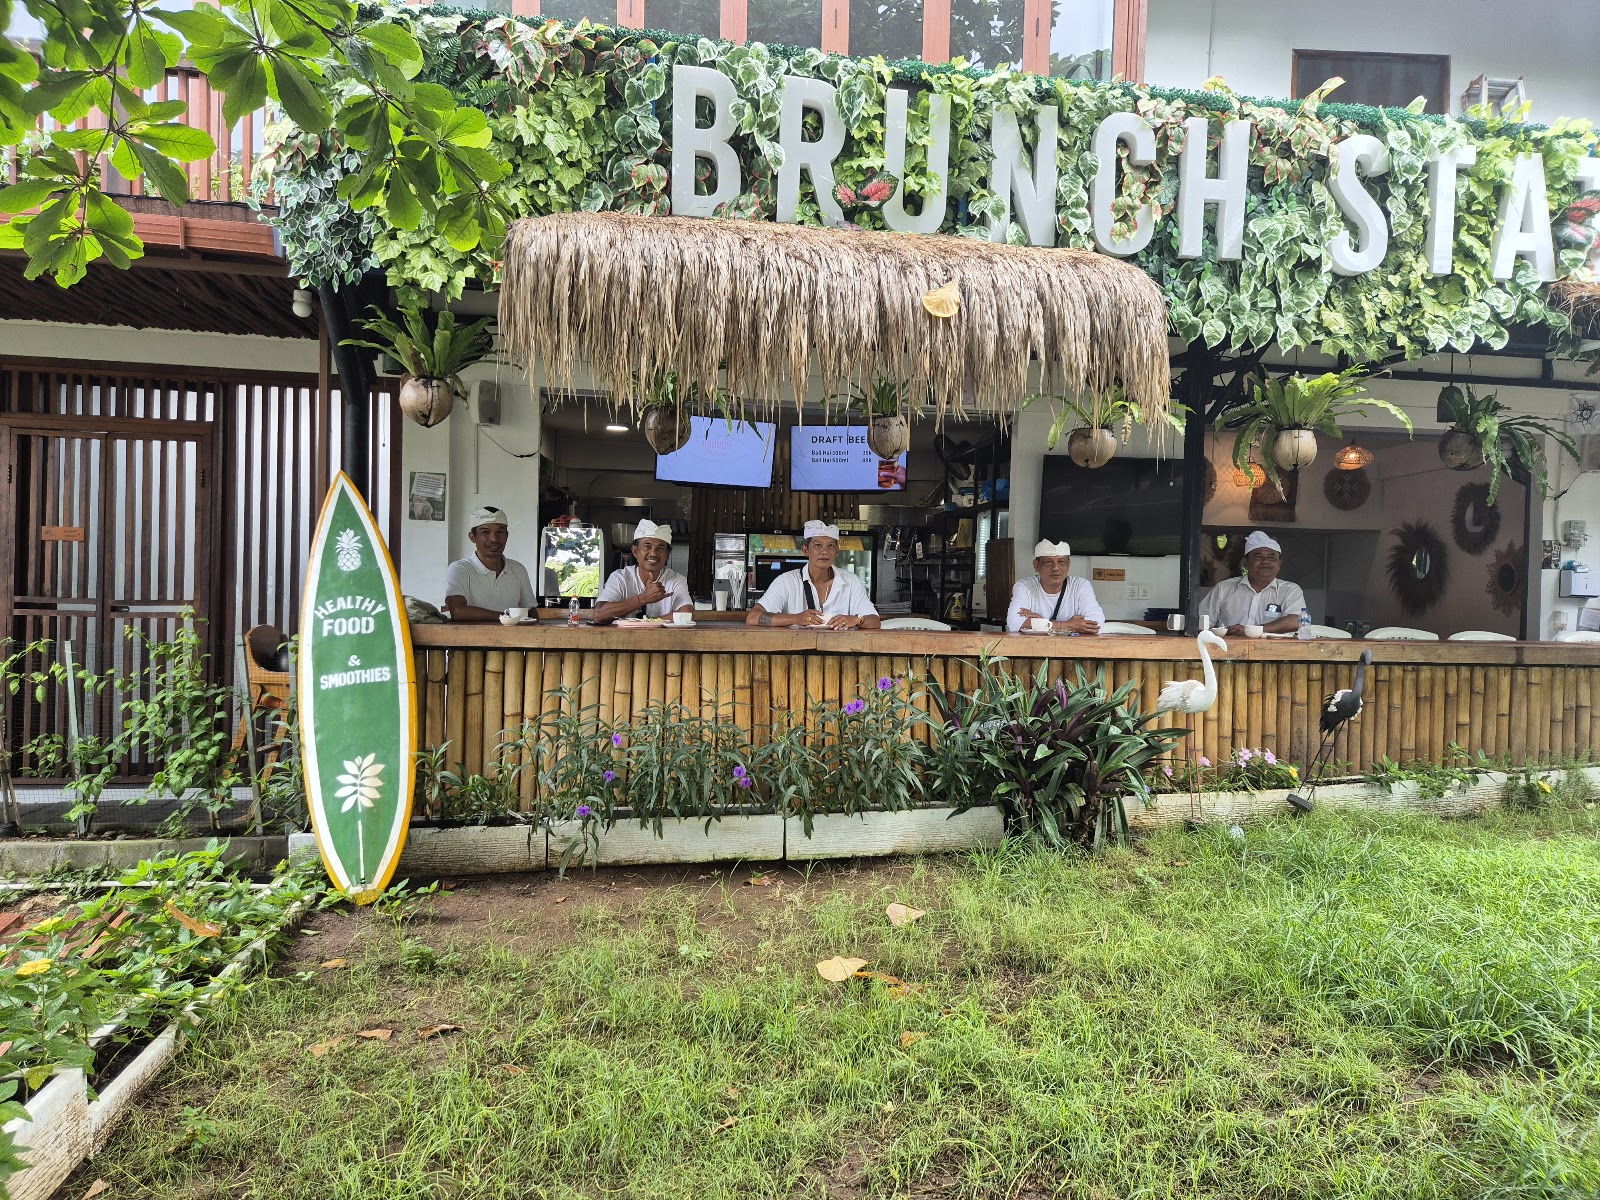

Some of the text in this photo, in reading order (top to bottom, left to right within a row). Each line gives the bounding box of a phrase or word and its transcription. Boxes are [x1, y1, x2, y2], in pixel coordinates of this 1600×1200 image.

[671, 65, 1249, 261] BRUNCH
[811, 435, 868, 444] DRAFT BEE
[314, 595, 386, 619] HEALTHY
[322, 616, 375, 637] FOOD
[348, 654, 361, 667] &
[320, 666, 391, 690] SMOOTHIES
